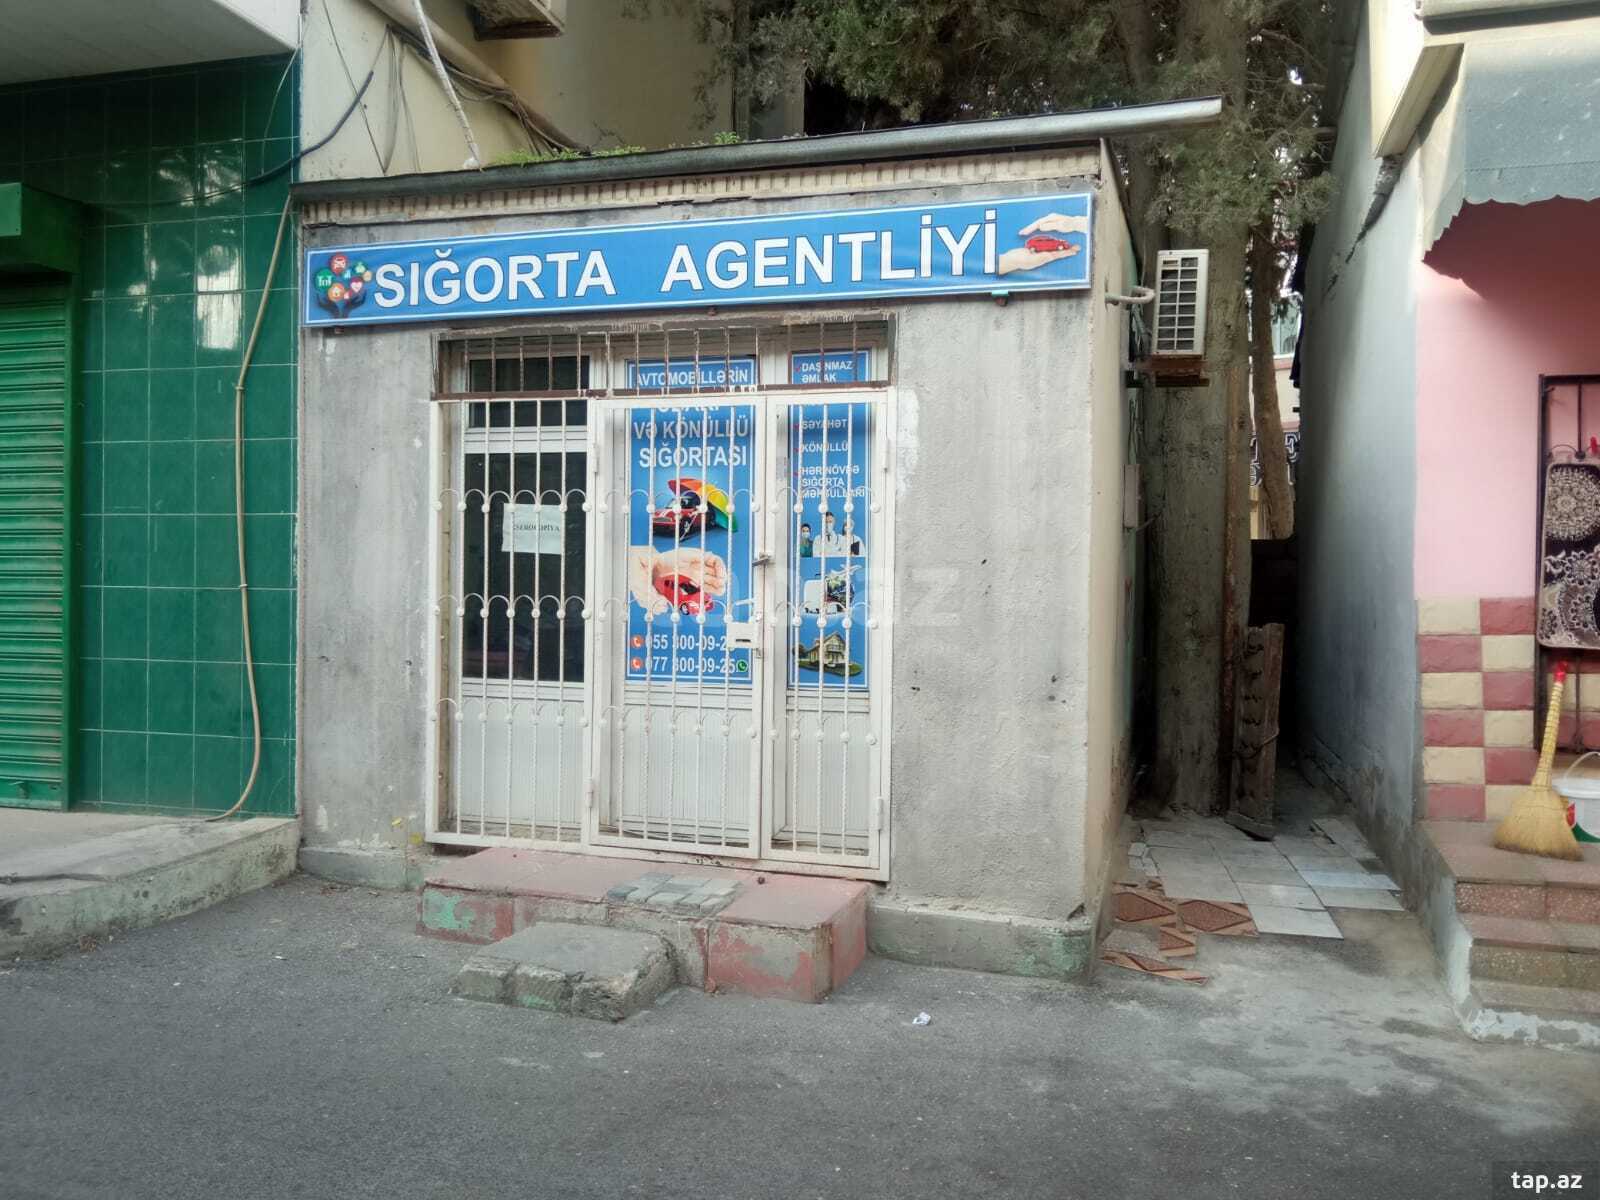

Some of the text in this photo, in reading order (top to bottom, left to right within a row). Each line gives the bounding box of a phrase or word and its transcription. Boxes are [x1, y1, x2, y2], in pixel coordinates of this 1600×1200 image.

[374, 209, 998, 308] SIĞORTA AGENTLİYİ
[802, 361, 853, 373] DAŞNMAZ
[636, 367, 747, 386] AVTOMOBLLƏRİN
[802, 418, 848, 430] SƏYHƏT
